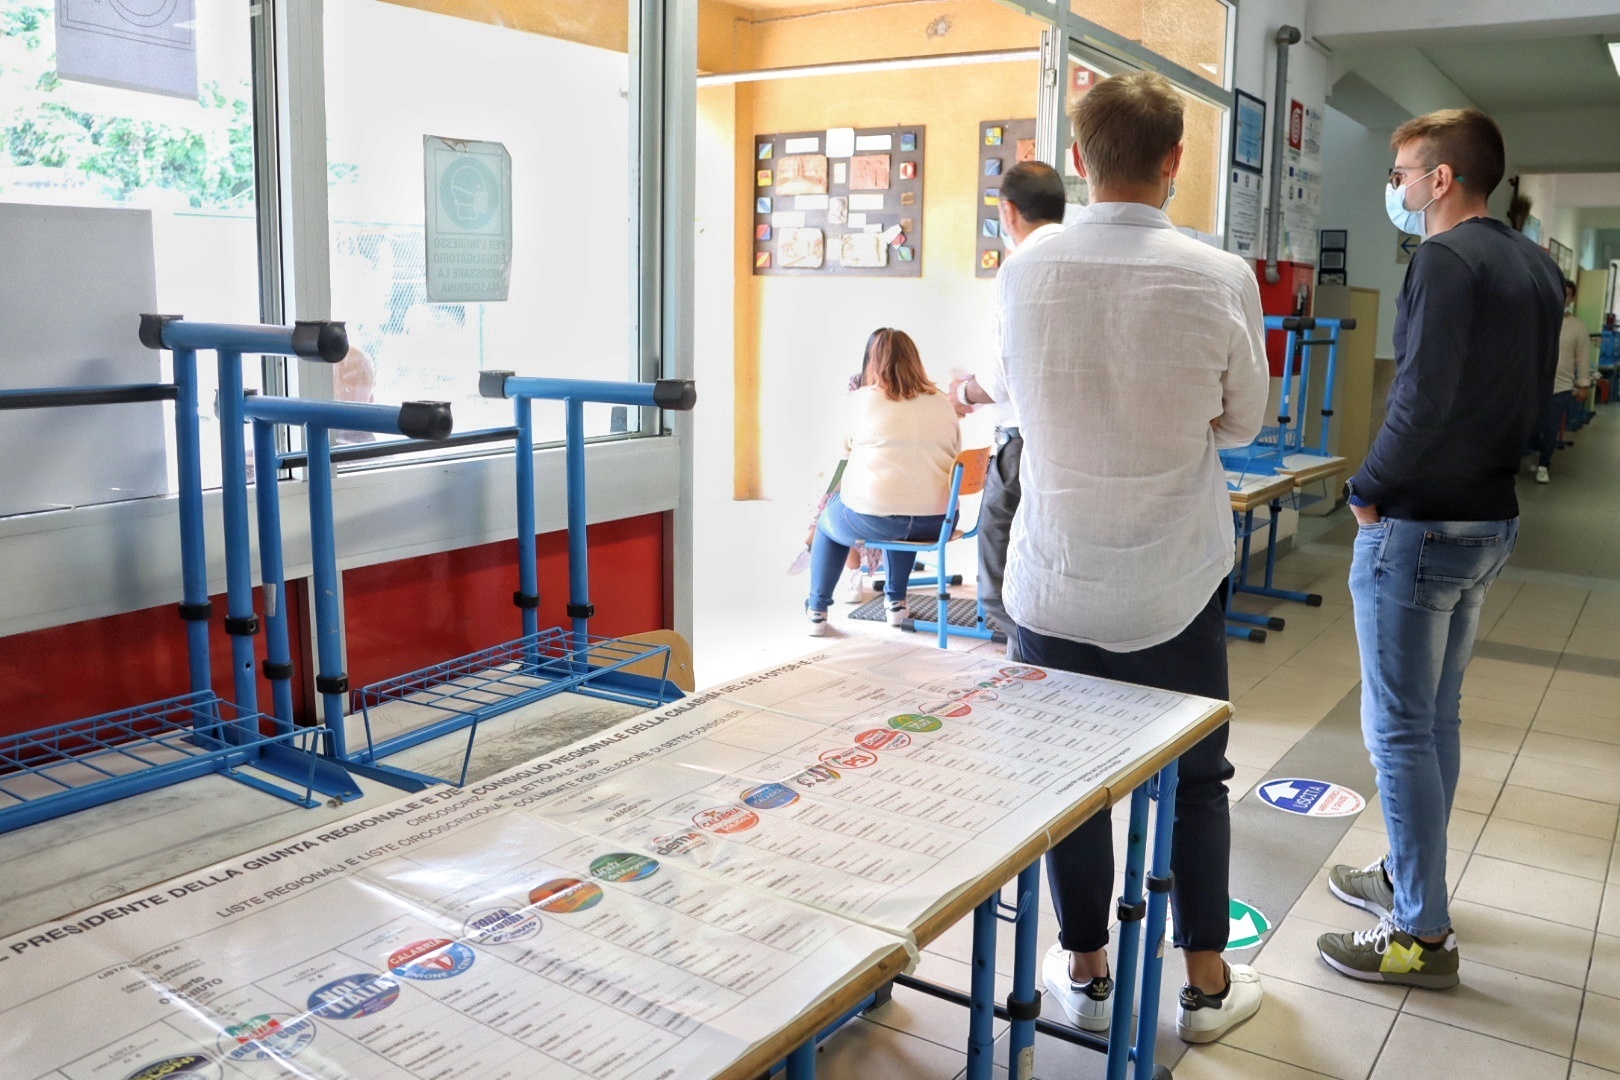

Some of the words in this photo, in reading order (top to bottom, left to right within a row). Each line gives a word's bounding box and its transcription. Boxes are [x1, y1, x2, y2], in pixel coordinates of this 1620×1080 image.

[1293, 785, 1324, 809] USCITA
[8, 894, 169, 955] PRESIDENTE
[166, 868, 245, 899] DELLA
[242, 839, 320, 871] GIUNTA
[316, 801, 424, 844] REGIONALE
[420, 796, 439, 806] E
[435, 787, 464, 801] DE
[471, 763, 554, 796] CONSIGLIO
[550, 732, 630, 766] REGIONALE
[627, 715, 670, 736] DELLA
[664, 691, 725, 718] CALABRIA
[215, 895, 266, 918] LISTE
[263, 863, 348, 900] REGIONALI
[343, 857, 360, 867] E
[357, 843, 399, 862] LISTE
[397, 803, 503, 847] CIRCOSCRIZIONA
[389, 938, 444, 964] CALABRIA
[315, 980, 360, 1002] NOI
